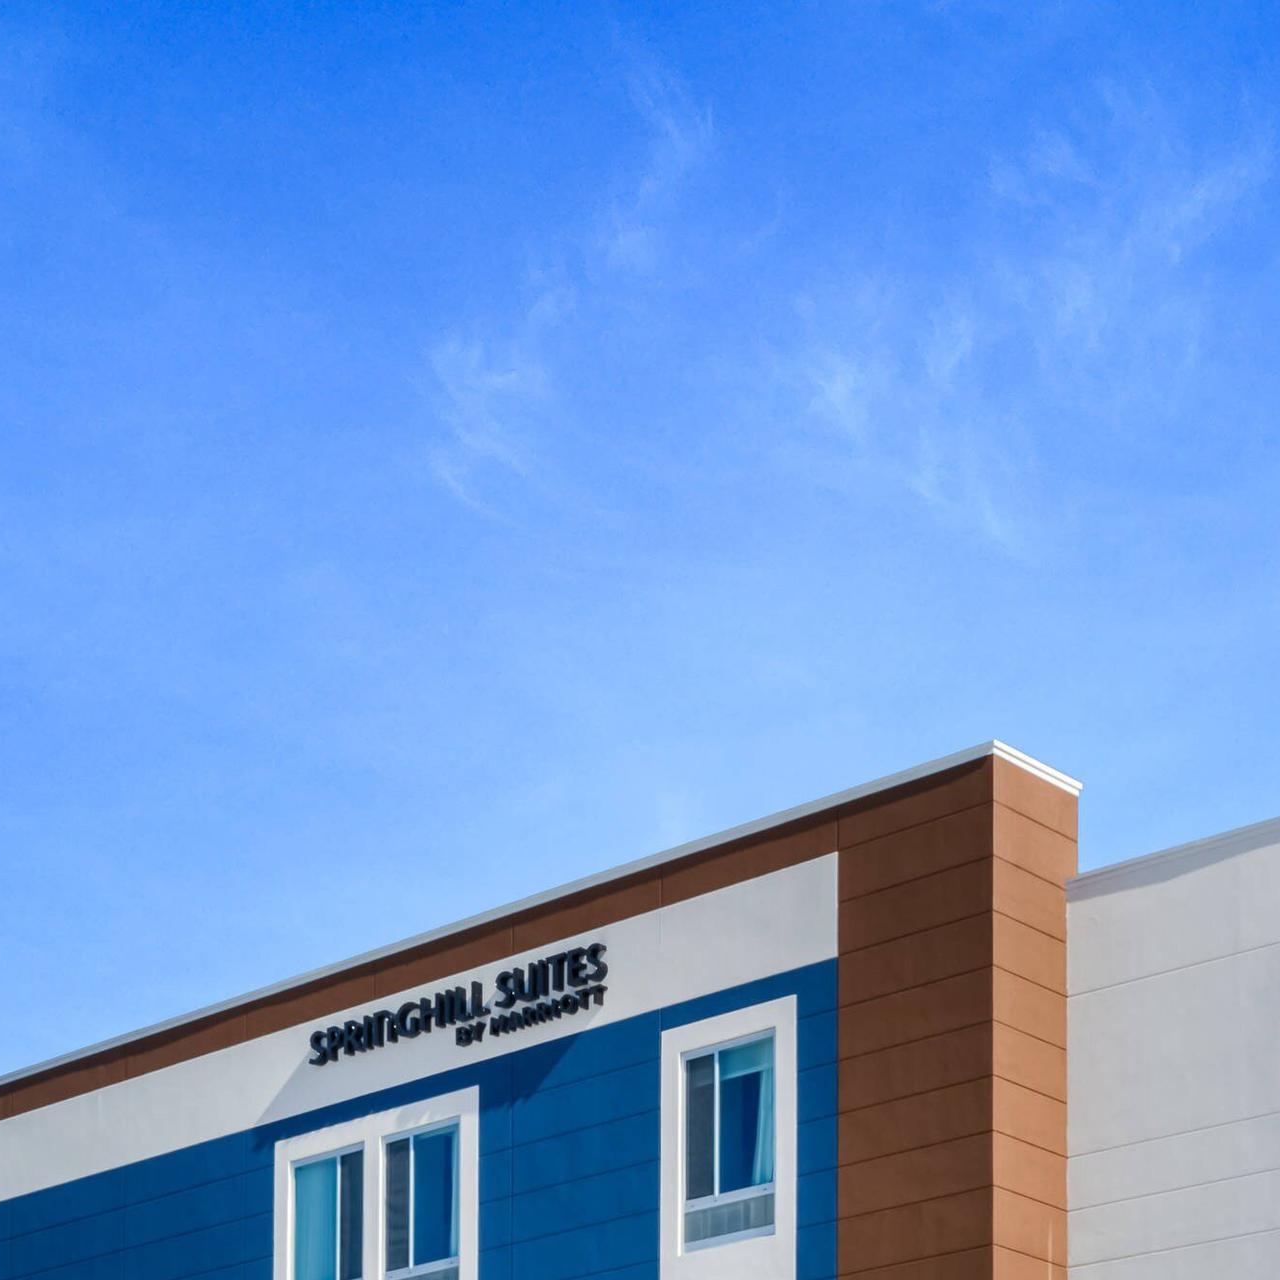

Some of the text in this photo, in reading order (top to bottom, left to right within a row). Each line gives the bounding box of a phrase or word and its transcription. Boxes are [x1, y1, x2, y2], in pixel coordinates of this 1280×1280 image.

[309, 943, 608, 1066] SPRINGHILL SUITES
[455, 984, 608, 1047] BY MARRIOTT
